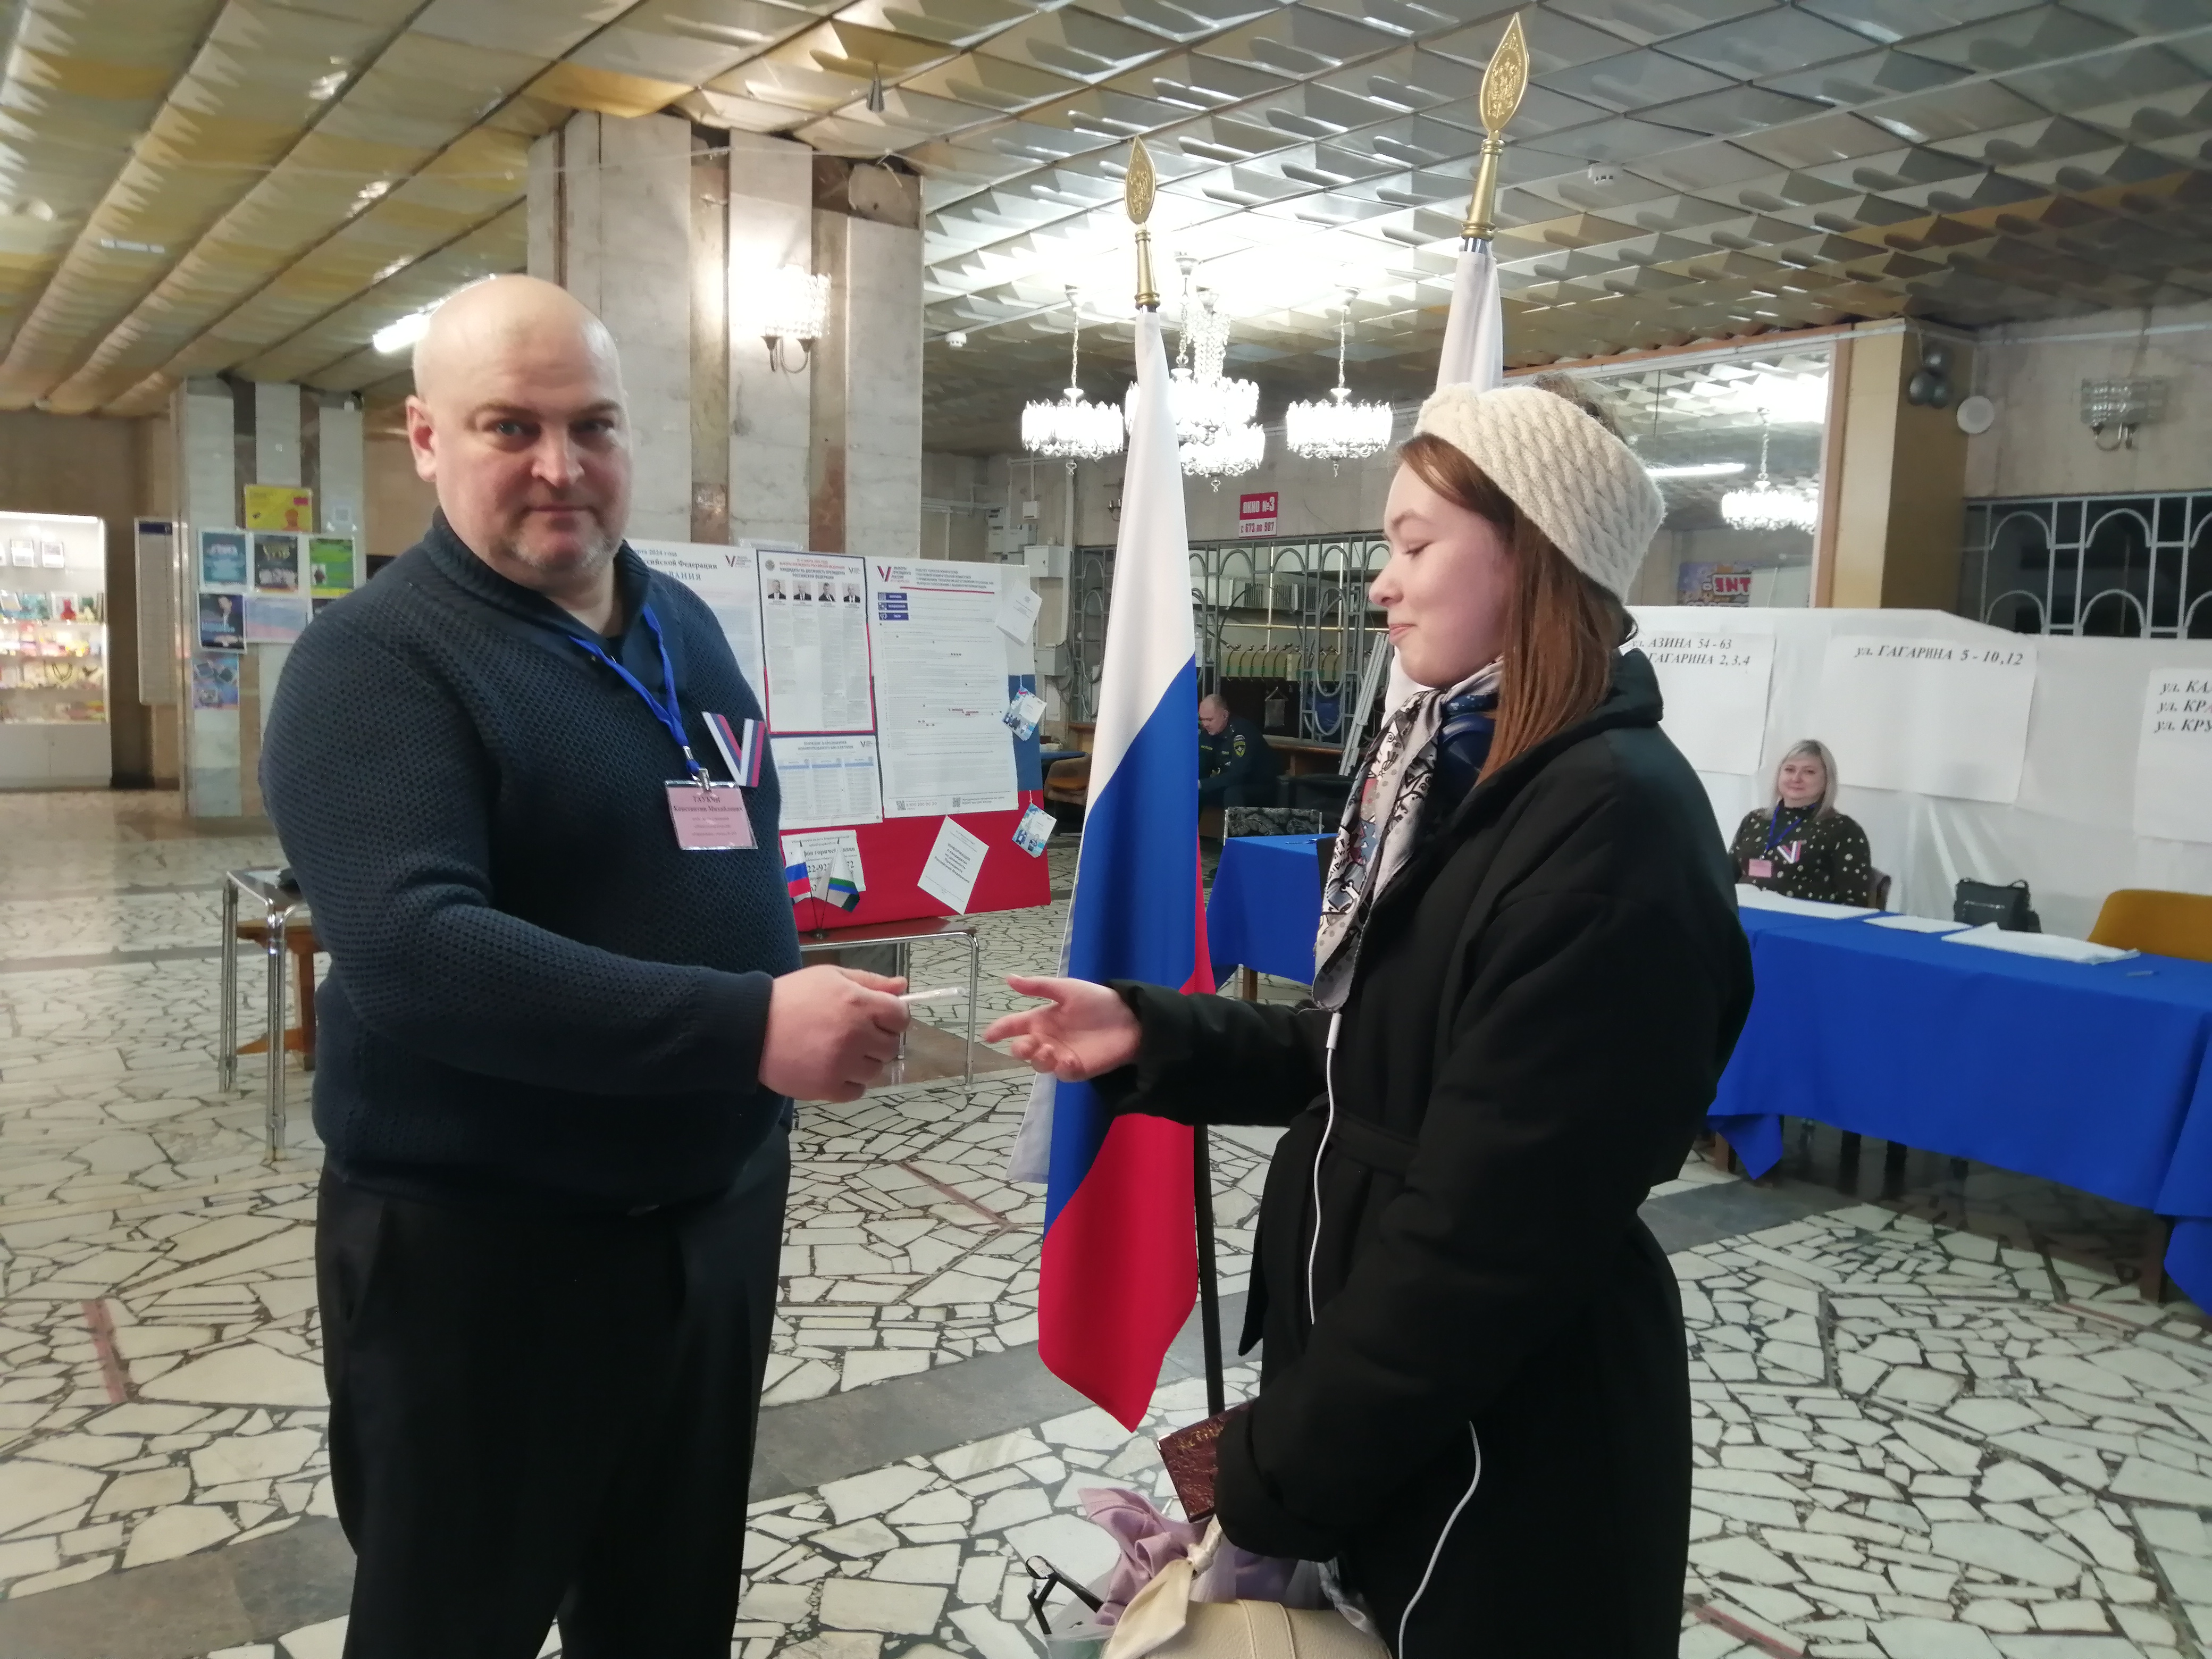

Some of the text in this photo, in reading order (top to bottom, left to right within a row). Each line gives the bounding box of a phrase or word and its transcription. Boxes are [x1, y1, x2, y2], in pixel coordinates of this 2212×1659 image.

[1243, 501, 1260, 514] ОКНО
[678, 560, 717, 569] Федерации
[668, 571, 702, 581] ВАНИЯ
[1648, 638, 1692, 648] АЗИНА
[1697, 639, 1710, 648] 54
[1719, 639, 1732, 649] 63
[1648, 652, 1714, 664] ГАГАРИНА
[1854, 646, 1873, 658] ул.
[1878, 644, 1953, 660] ГАГАРИНА
[1960, 649, 1970, 661] 5
[2159, 679, 2212, 696] ул. КА
[2157, 702, 2177, 714] ул.
[2154, 720, 2175, 734] ул.
[948, 843, 971, 861] ИНФОРМАЦИЯ
[807, 863, 830, 873] 22-92
